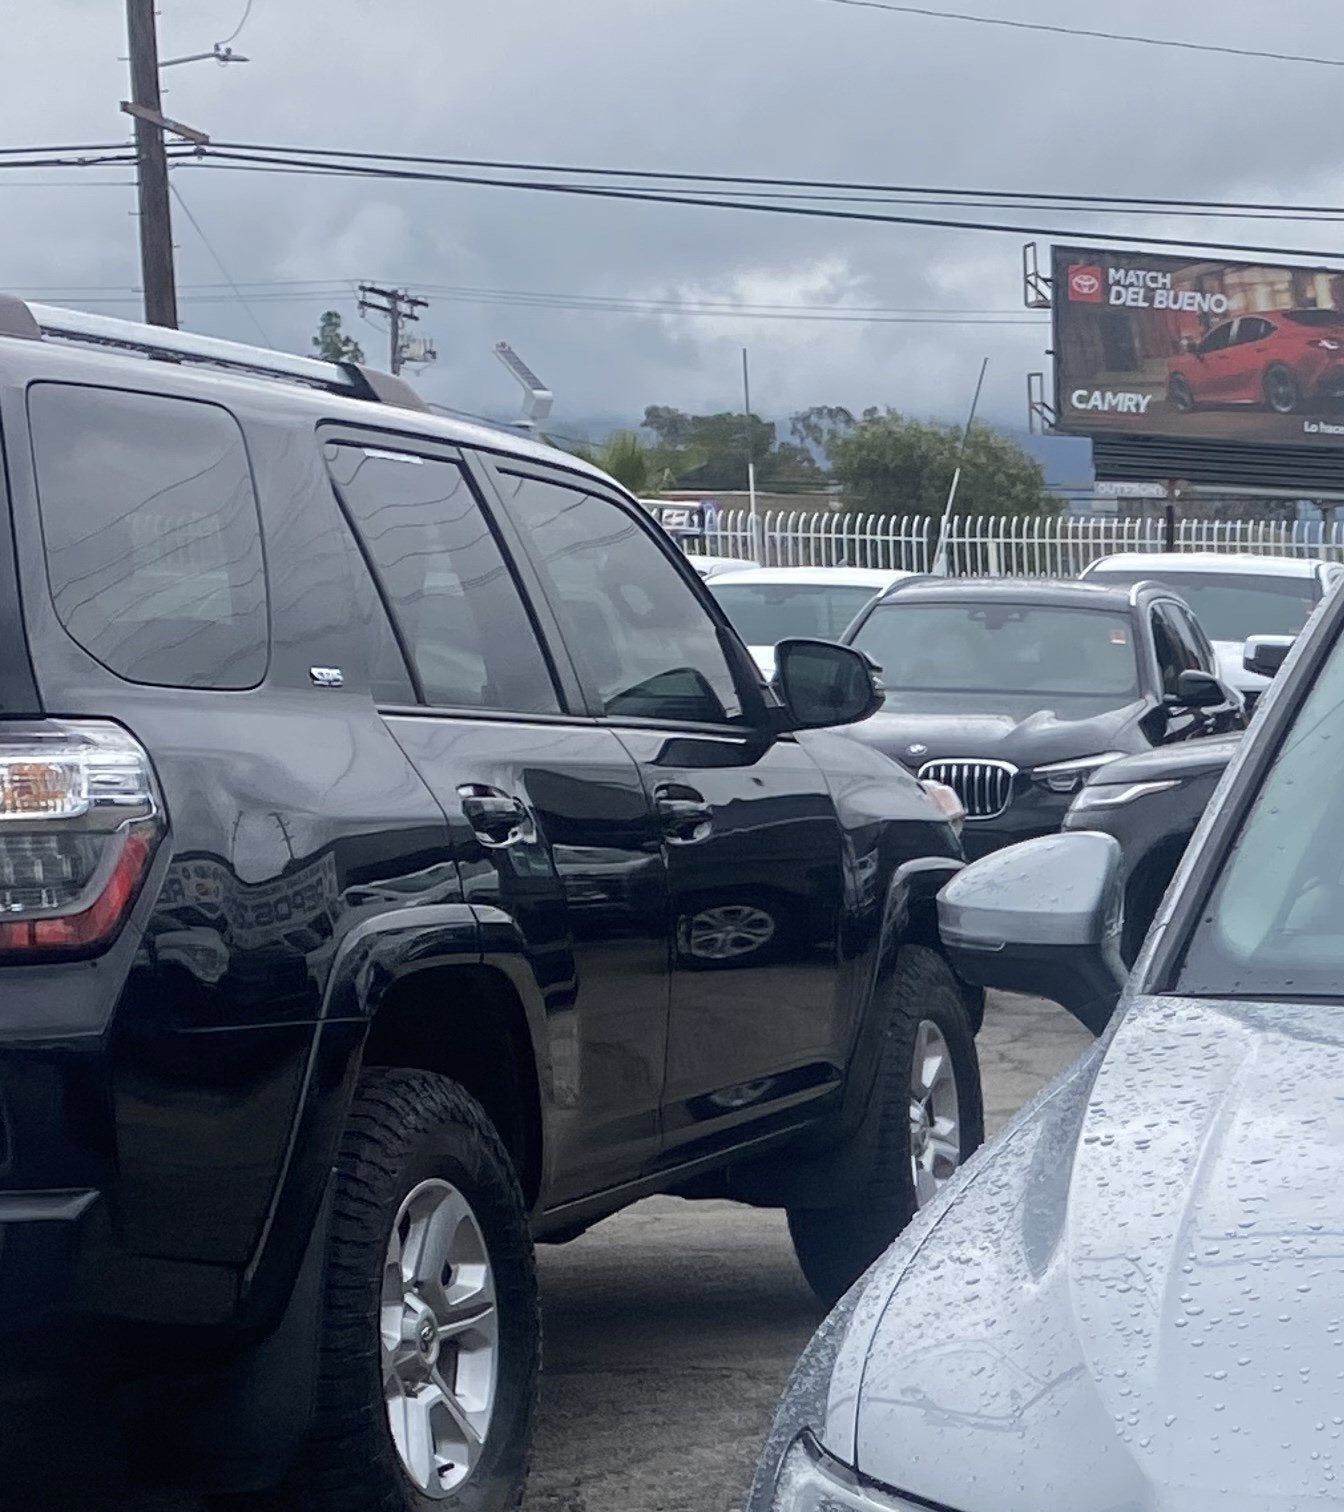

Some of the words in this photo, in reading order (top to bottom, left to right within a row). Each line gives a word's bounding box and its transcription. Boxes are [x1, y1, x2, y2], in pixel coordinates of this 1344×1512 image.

[1108, 267, 1171, 289] MATCH
[1109, 285, 1149, 308] DEL
[1153, 289, 1228, 314] BUENO
[1071, 389, 1152, 413] CAMRY
